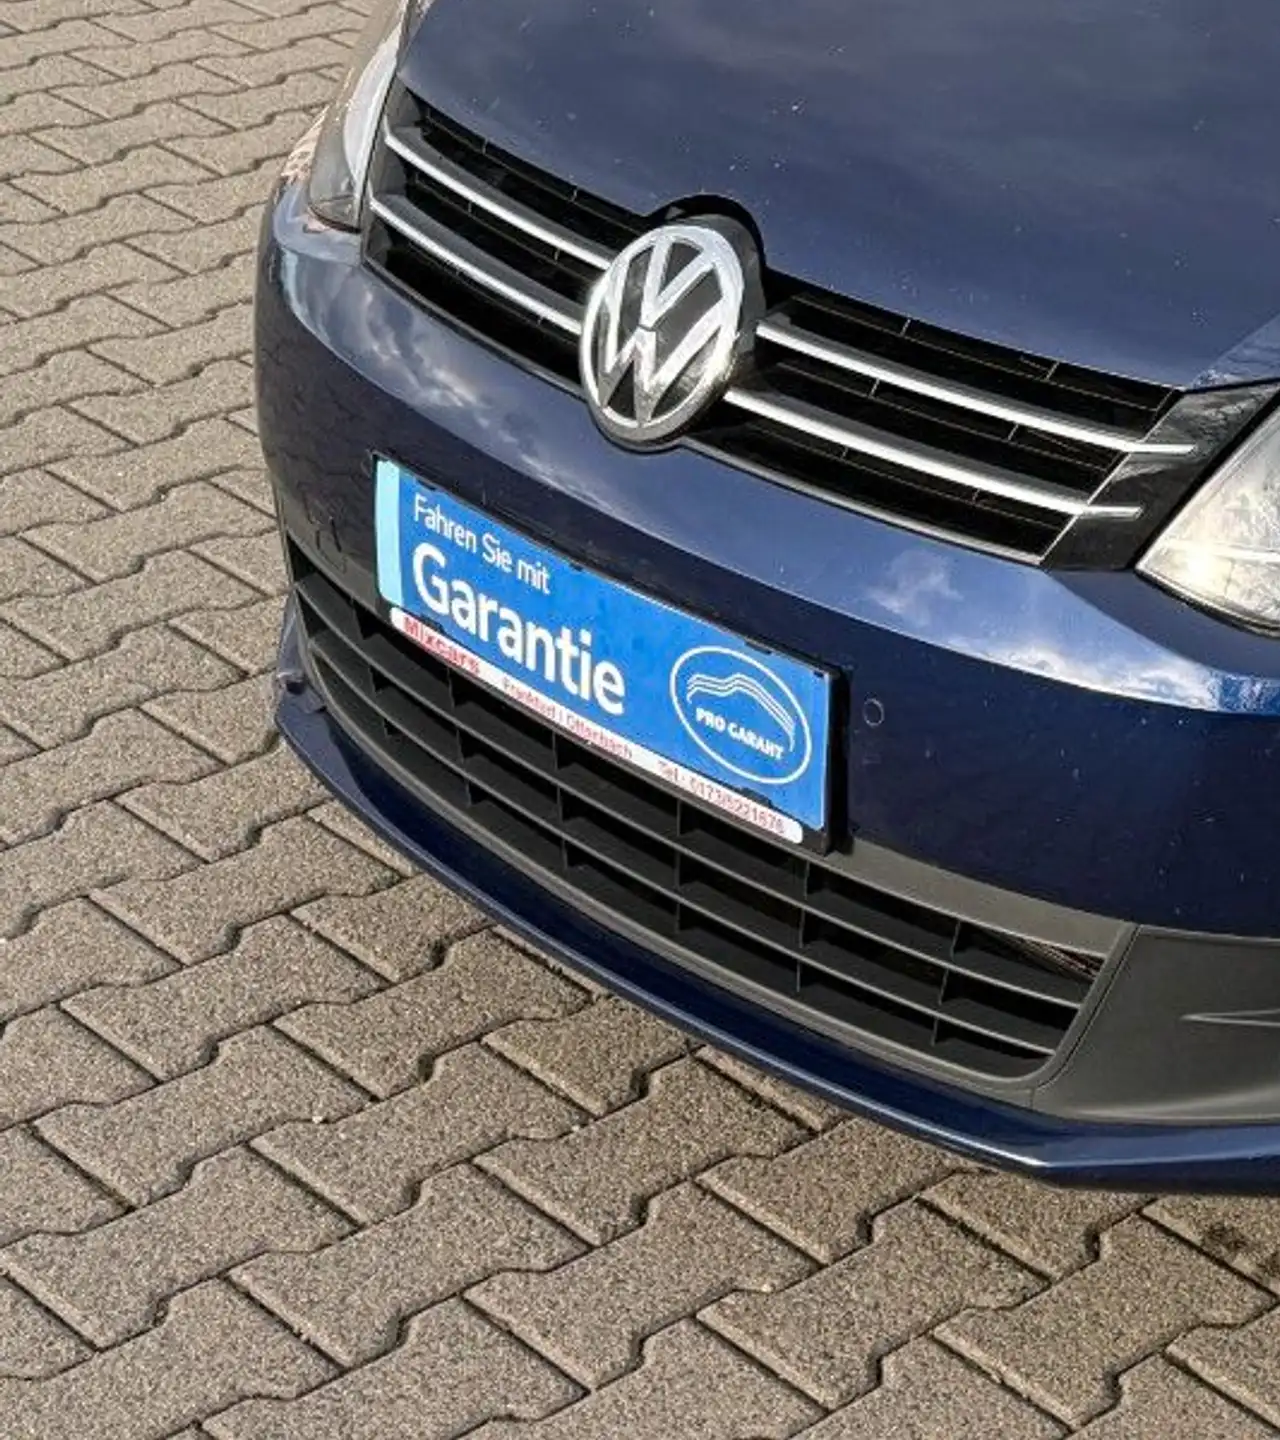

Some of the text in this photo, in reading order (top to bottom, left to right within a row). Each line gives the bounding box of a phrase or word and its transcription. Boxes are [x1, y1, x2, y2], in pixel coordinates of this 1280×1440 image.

[414, 493, 551, 595] Fahren Sie mit
[411, 542, 627, 717] Garantie
[695, 707, 786, 761] PRO GARANT
